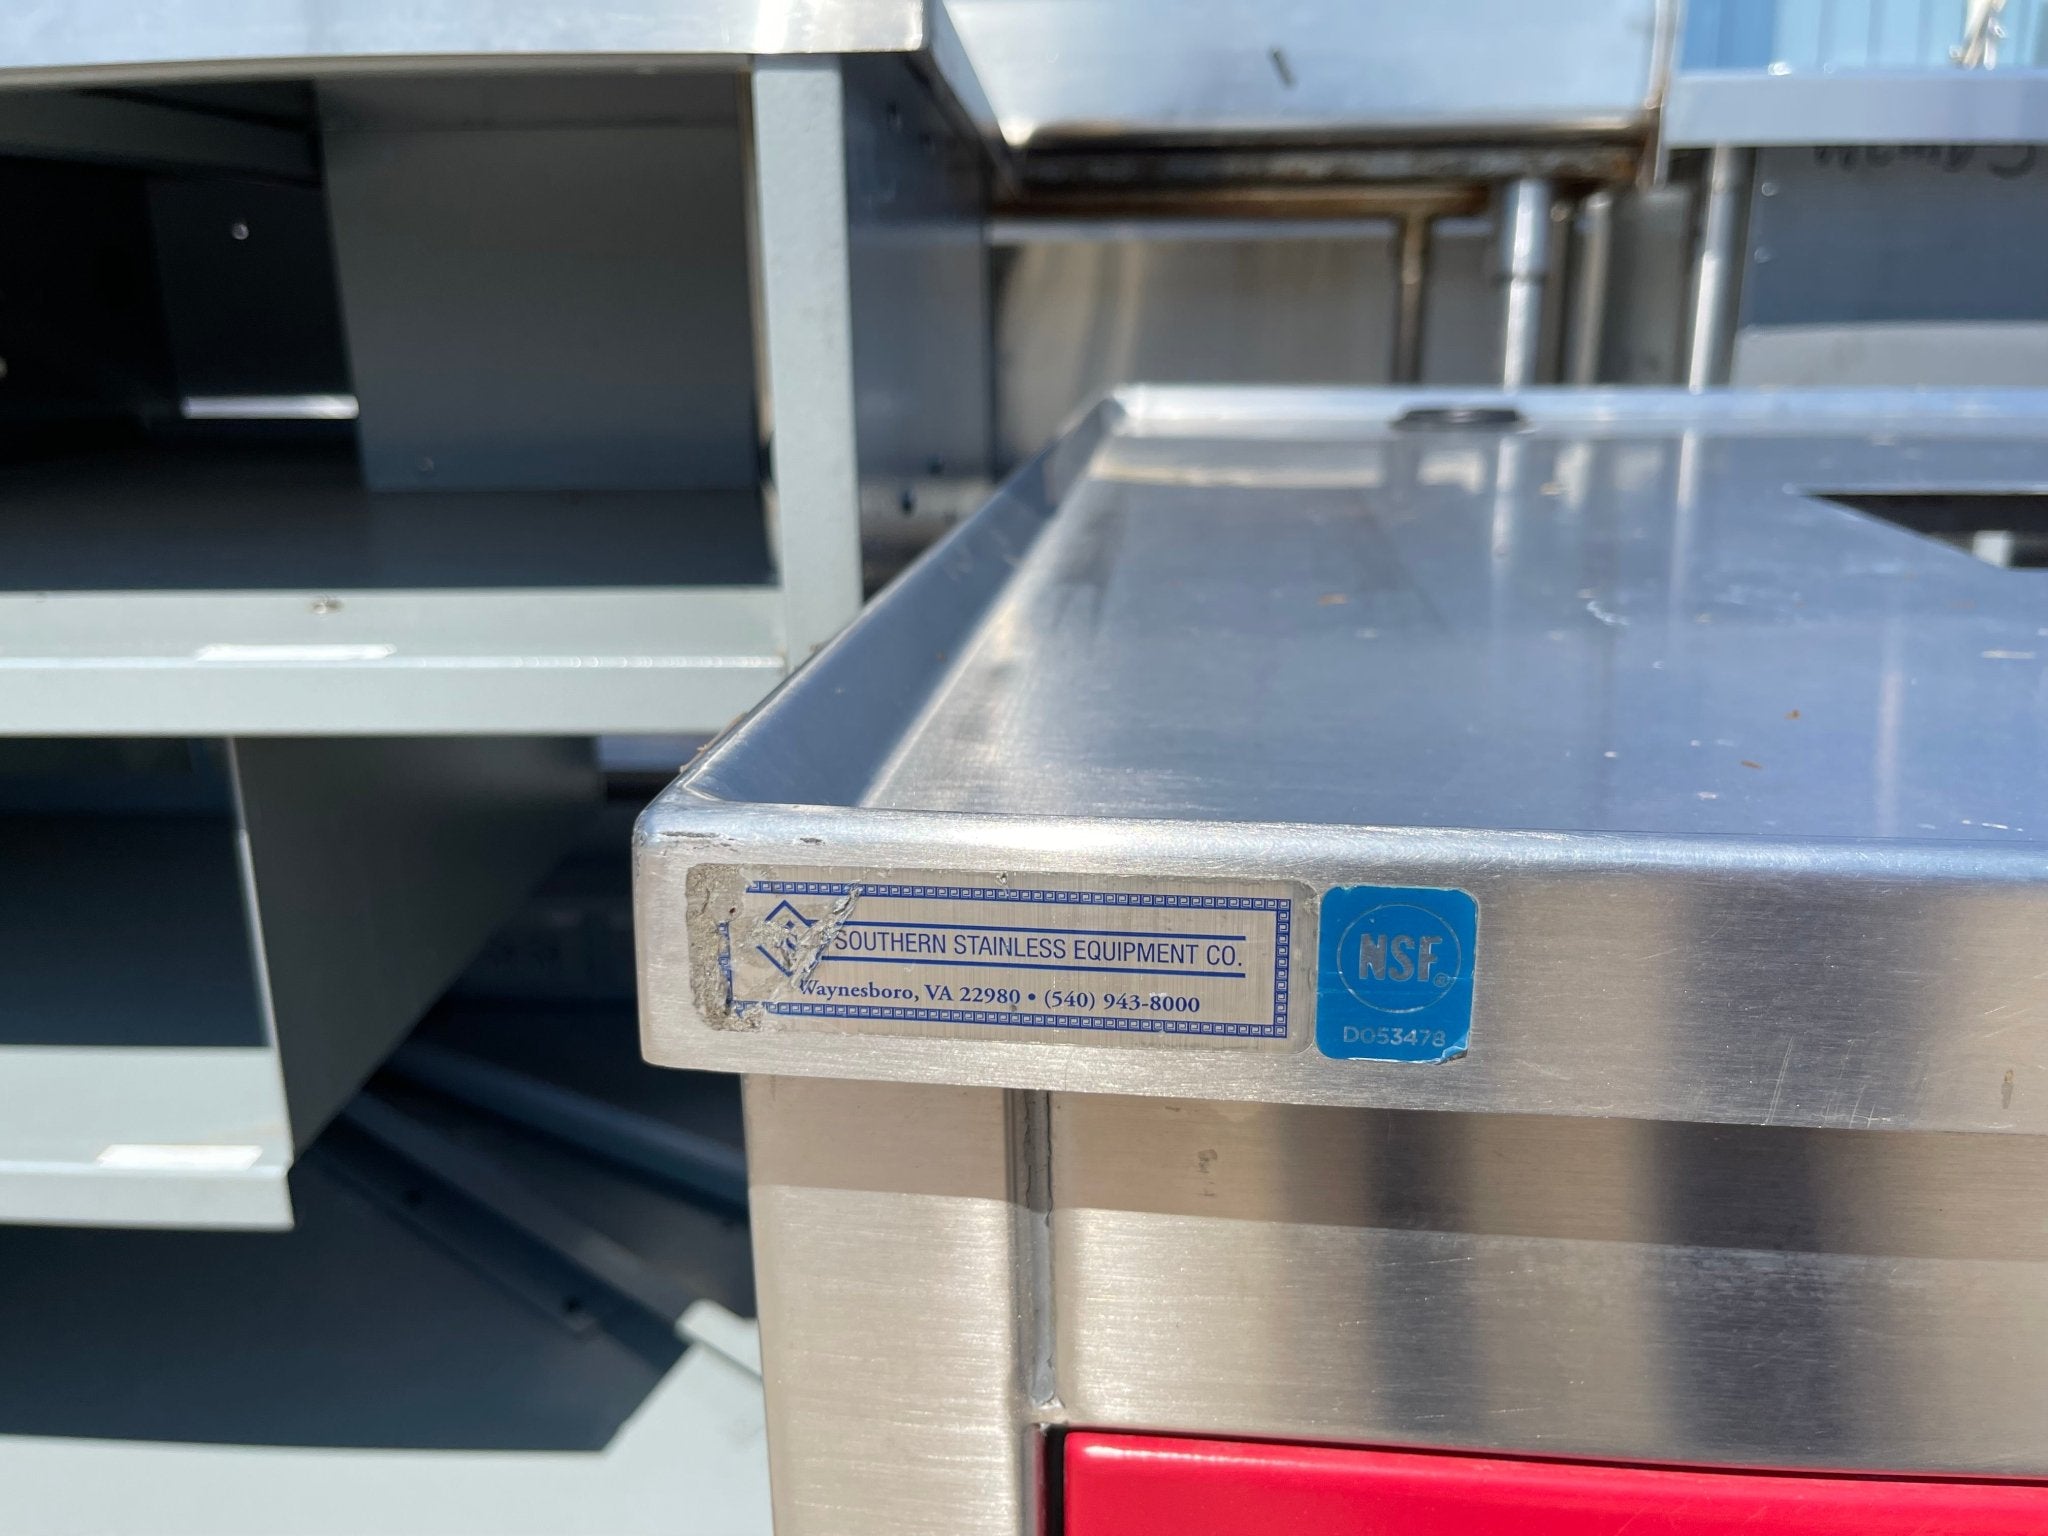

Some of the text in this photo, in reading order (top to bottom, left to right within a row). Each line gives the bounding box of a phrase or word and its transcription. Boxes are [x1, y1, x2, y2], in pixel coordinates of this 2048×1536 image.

[834, 929, 1243, 967] SOUTHERN STAINLESS EQUIPMENT CO.
[800, 978, 1201, 1013] Waynesboro, VA 22980 (540) 943-8000
